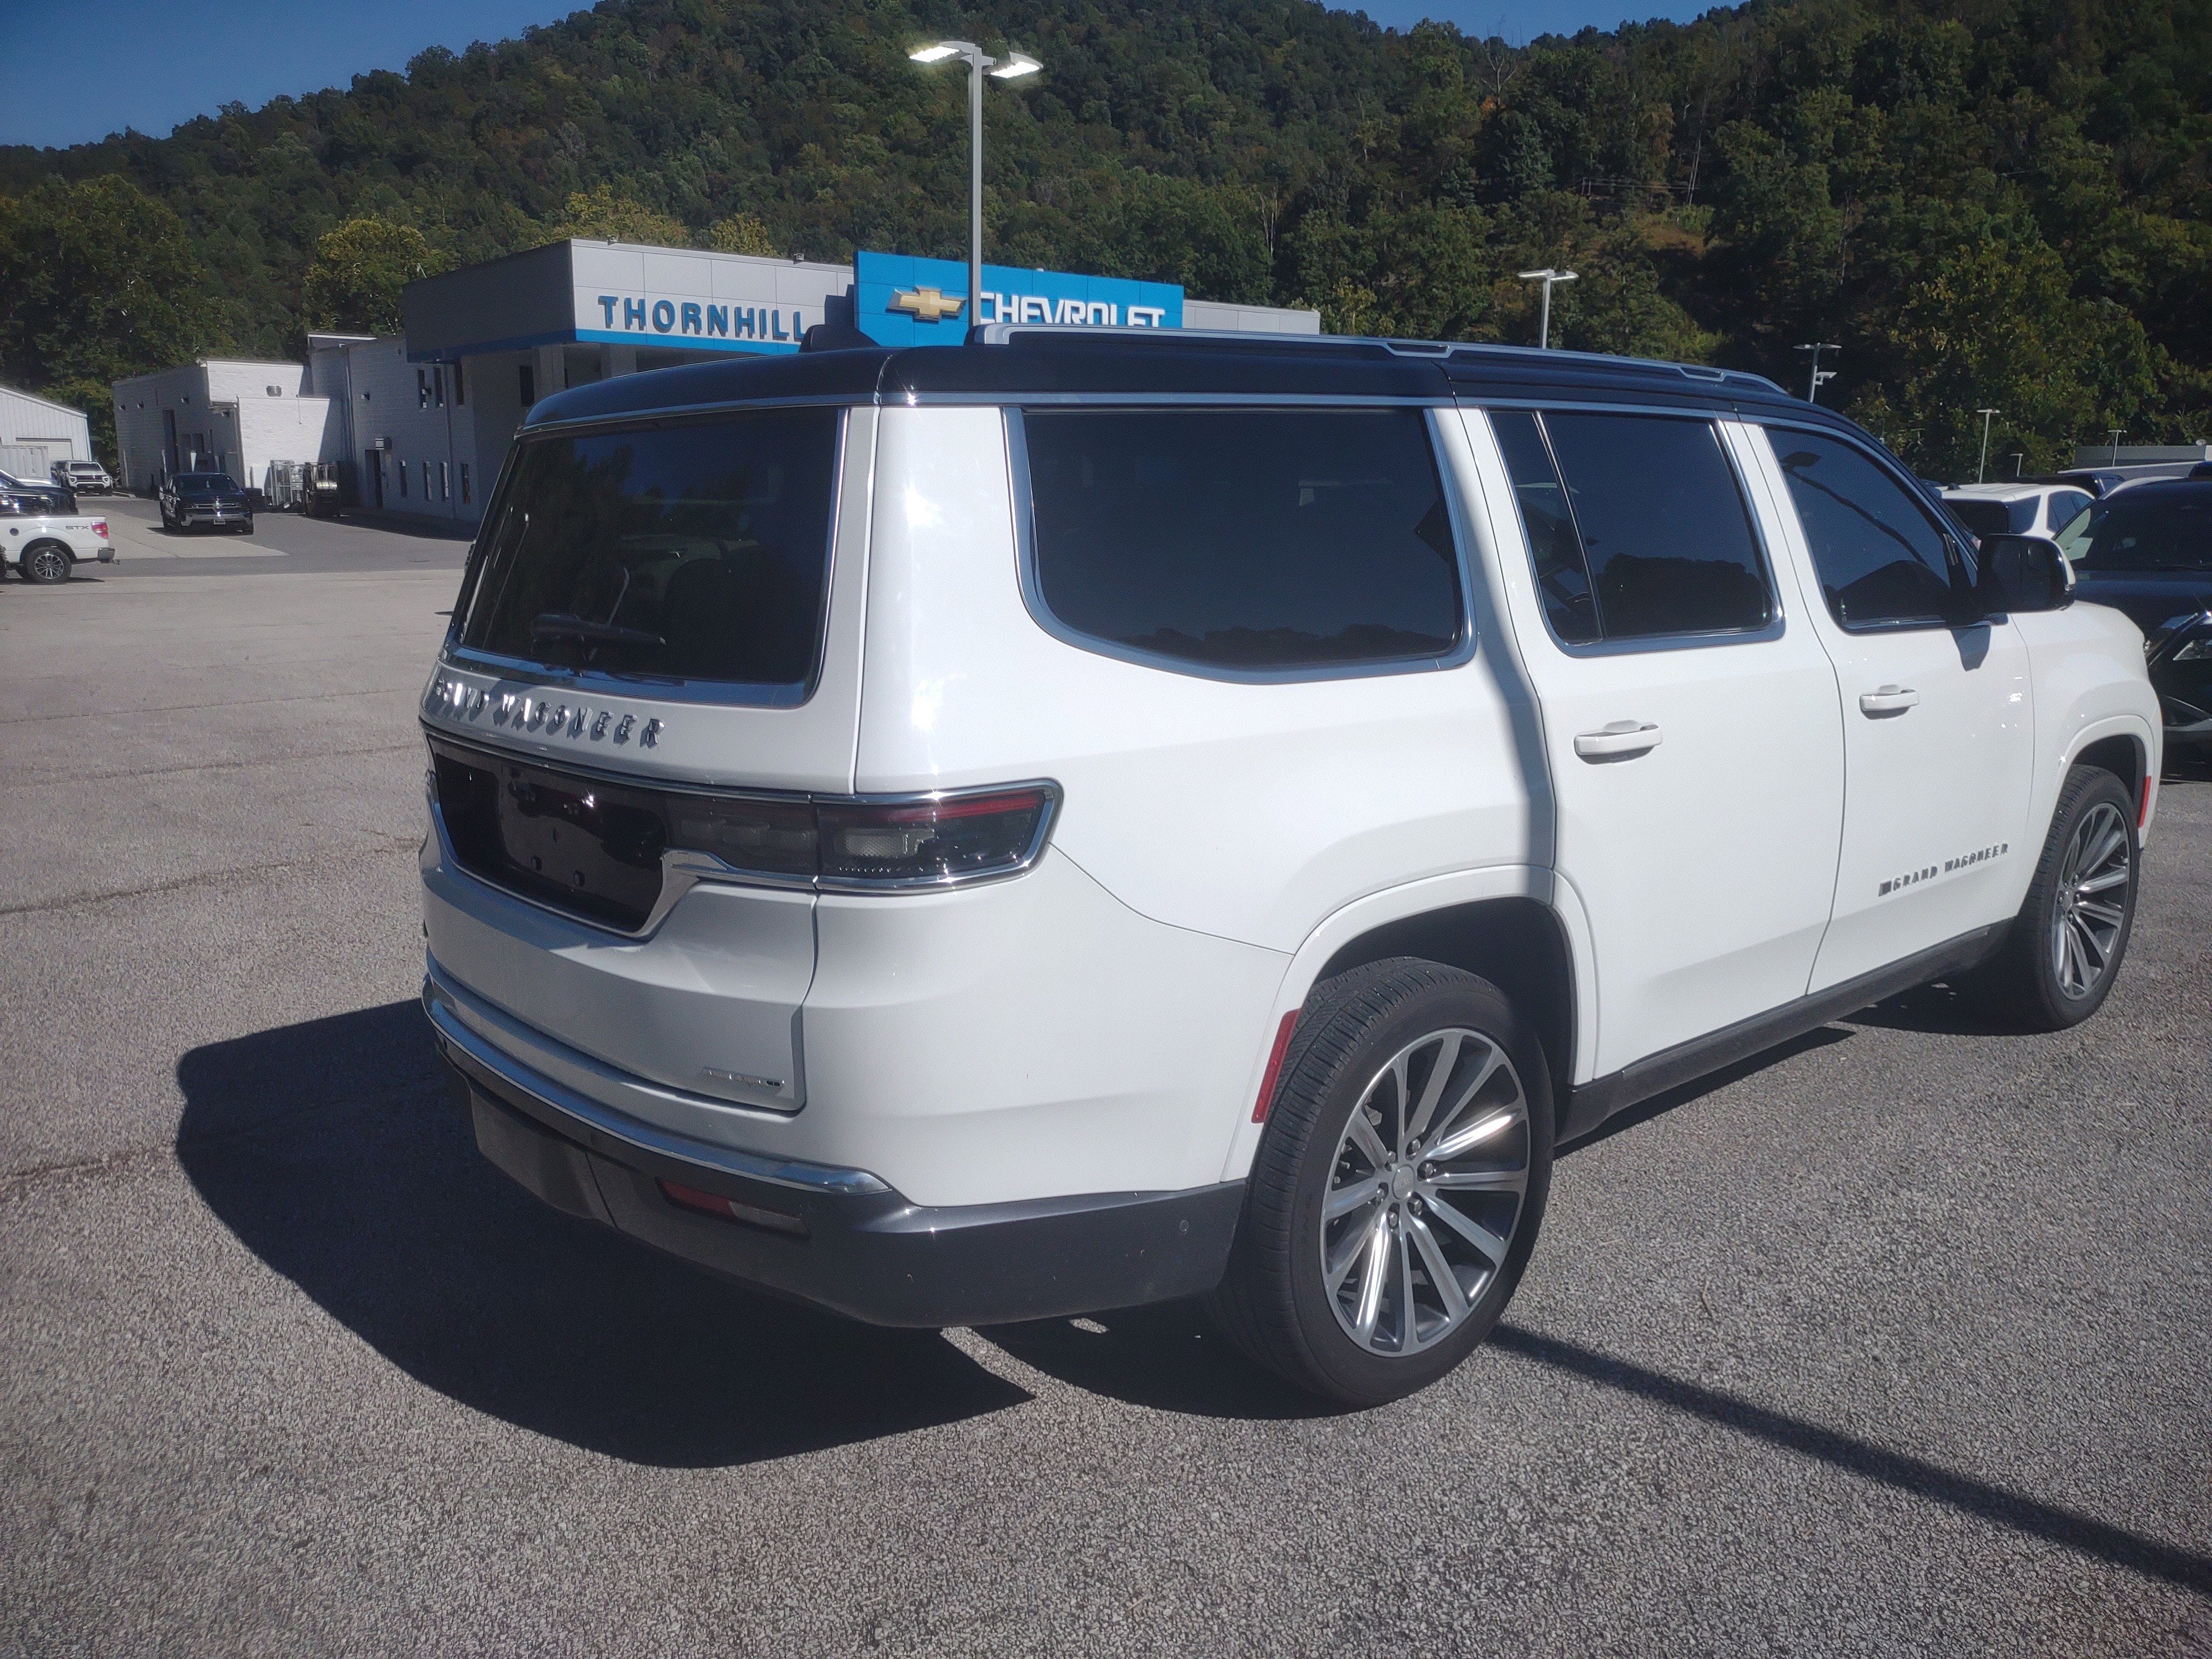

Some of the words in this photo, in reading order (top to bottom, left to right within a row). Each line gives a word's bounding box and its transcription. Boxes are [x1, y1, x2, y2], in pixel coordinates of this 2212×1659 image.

[598, 295, 805, 340] THORNHILL
[1893, 866, 1938, 891] GRAND
[1944, 843, 2008, 873] WAGONEER
